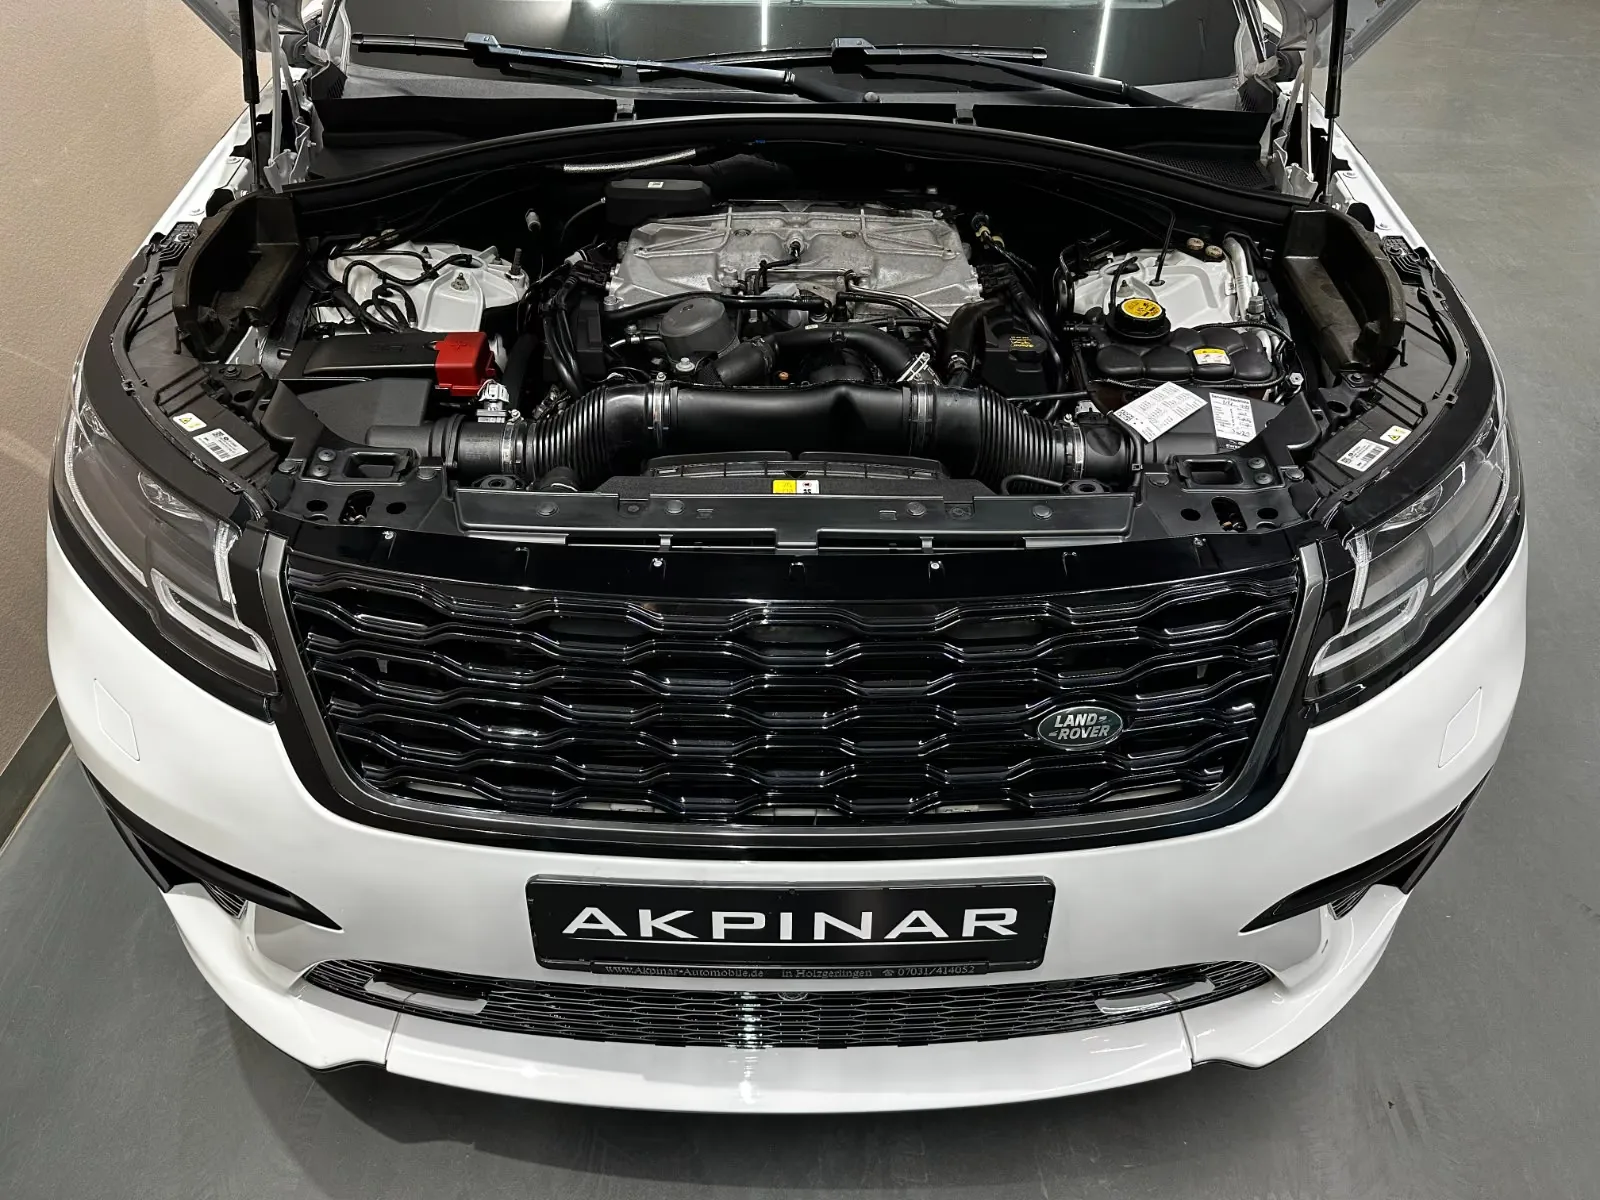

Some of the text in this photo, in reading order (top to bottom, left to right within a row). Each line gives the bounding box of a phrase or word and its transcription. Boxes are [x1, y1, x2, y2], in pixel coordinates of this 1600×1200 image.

[1054, 713, 1098, 728] LAND
[1057, 725, 1111, 740] ROVER
[562, 907, 1018, 940] AKPINAR
[781, 969, 793, 978] in
[795, 969, 873, 979] Holzgerlingen
[897, 965, 975, 977] 07031/414052
